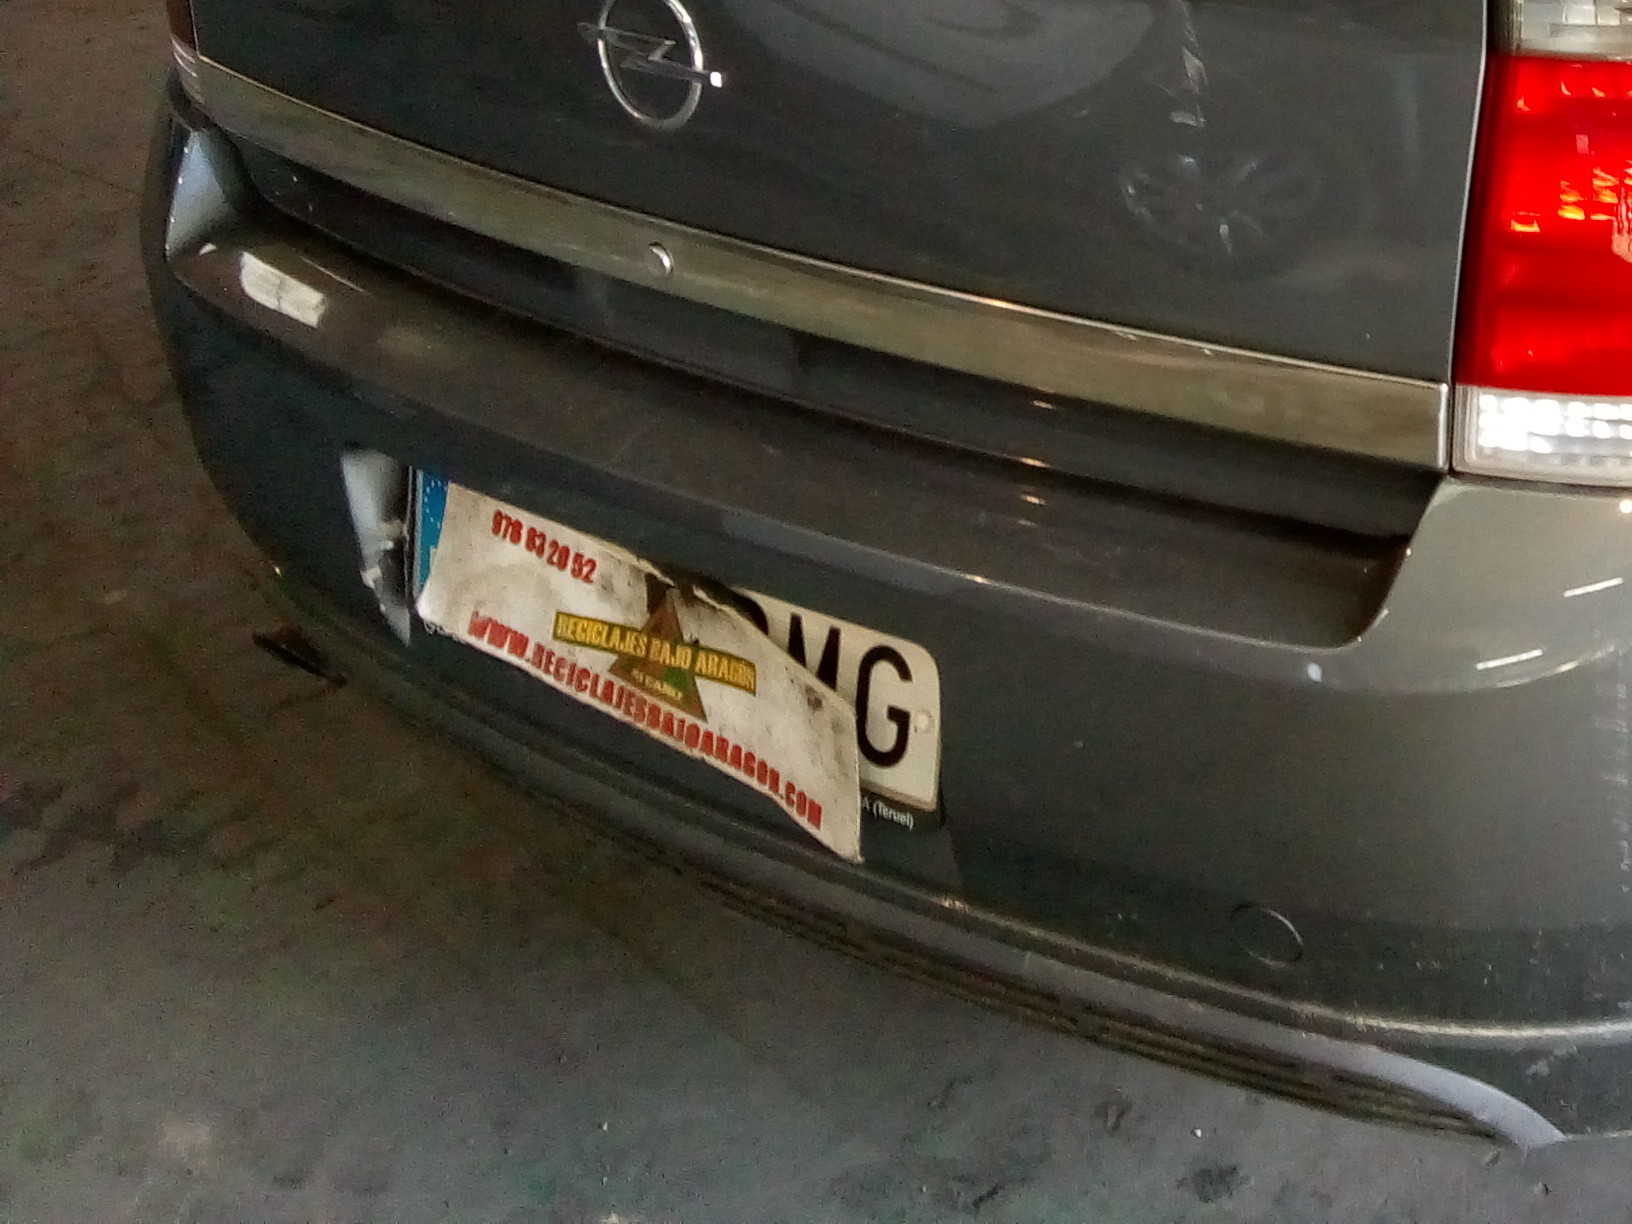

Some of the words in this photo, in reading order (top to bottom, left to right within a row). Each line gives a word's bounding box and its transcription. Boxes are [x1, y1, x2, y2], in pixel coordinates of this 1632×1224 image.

[491, 509, 523, 545] 978
[571, 551, 597, 584] 52
[556, 612, 648, 658] RECICLAJES
[650, 636, 693, 670] BAJO
